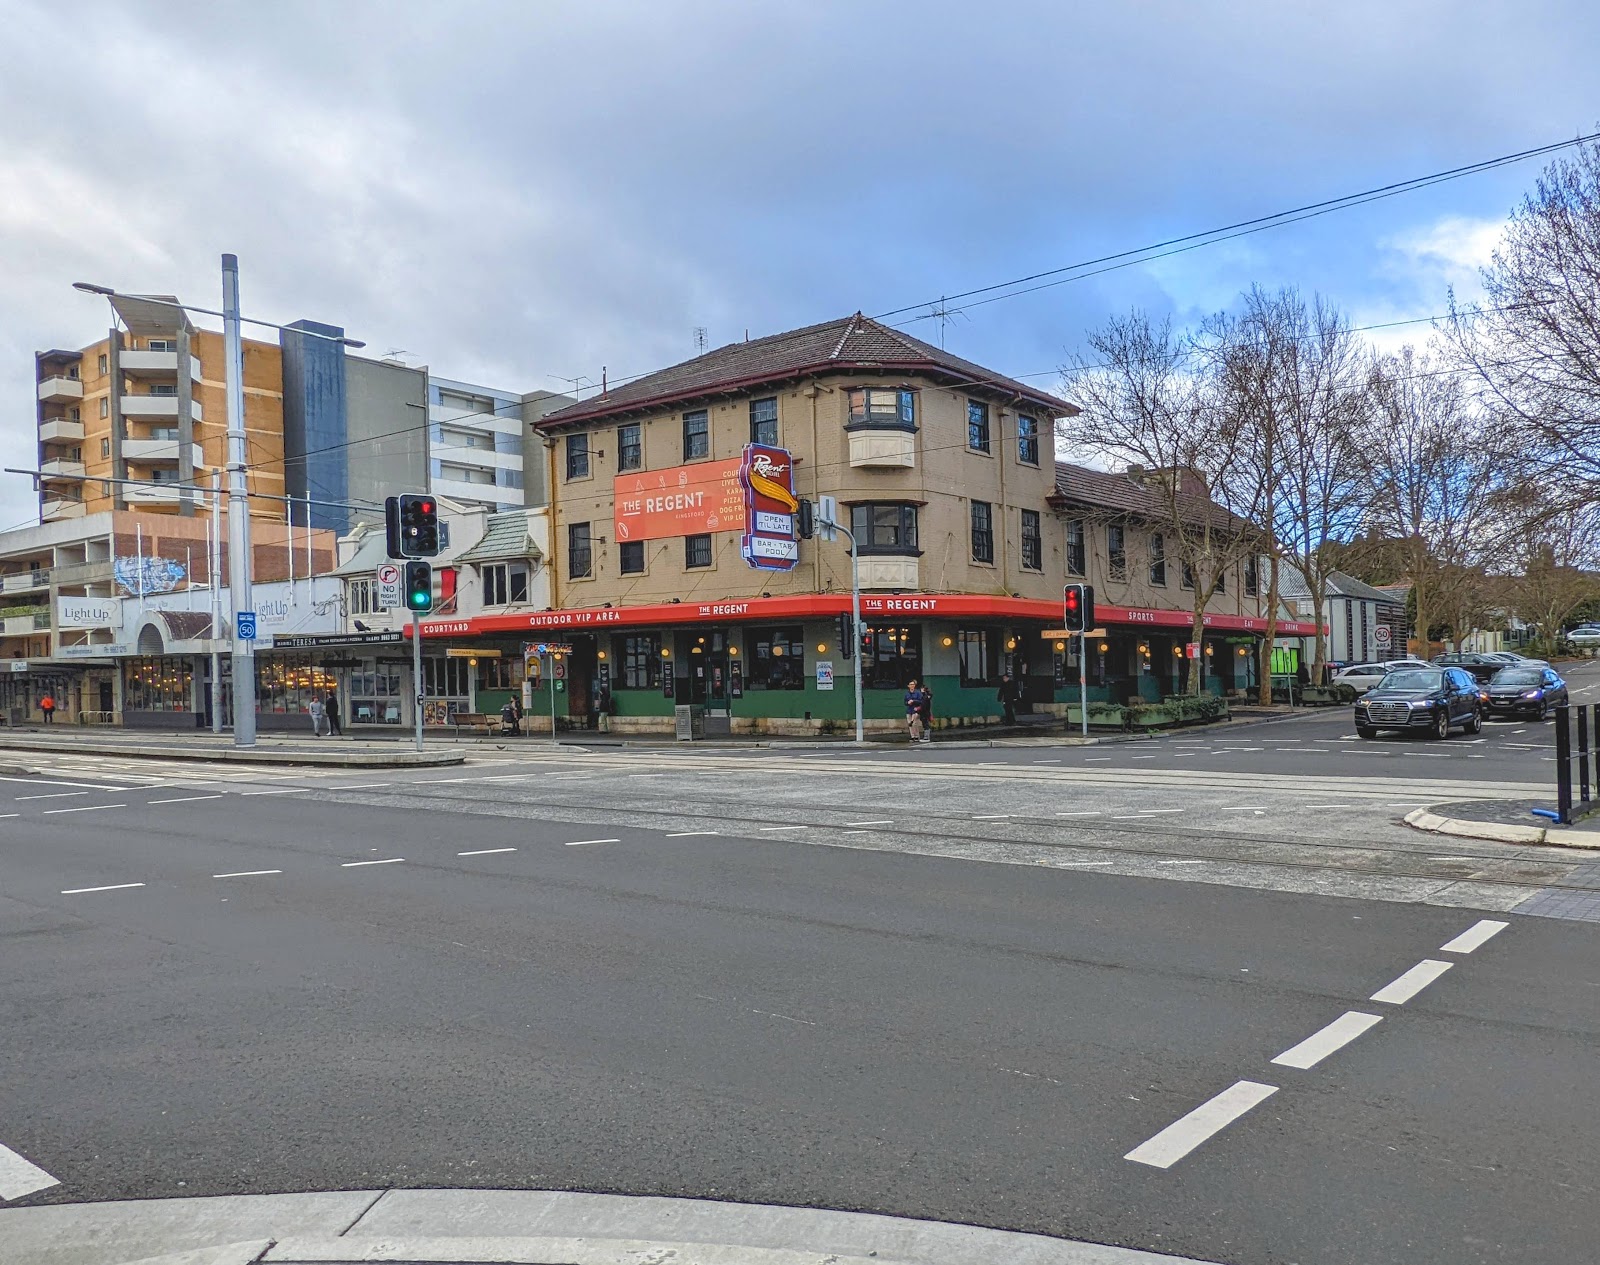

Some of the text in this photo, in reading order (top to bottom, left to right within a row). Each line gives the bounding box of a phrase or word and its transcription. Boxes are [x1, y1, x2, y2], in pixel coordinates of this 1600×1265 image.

[753, 454, 790, 478] Regent
[721, 479, 735, 487] LIVE
[726, 487, 744, 496] KARA
[622, 491, 704, 514] THE REGENT
[723, 496, 742, 505] PIZZA
[719, 506, 733, 514] DOG
[675, 511, 705, 519] KINGSFORD
[735, 513, 744, 521] LO
[764, 515, 784, 523] OPEN
[757, 540, 772, 548] BAR
[778, 542, 792, 550] TAB
[765, 548, 785, 556] POOL
[382, 585, 395, 593] NO
[713, 603, 749, 615] REGENT
[886, 600, 937, 610] REGENT
[64, 607, 91, 621] Light
[93, 608, 109, 622] Up
[254, 600, 274, 623] Light
[275, 599, 289, 621] Up
[529, 611, 620, 626] OUTDOOR VIP AREA
[1128, 611, 1154, 622] SPORTS
[423, 622, 469, 634] COURTYARD
[1244, 620, 1254, 628] EAT
[241, 626, 253, 634] 50
[1377, 630, 1388, 638] 50
[292, 637, 317, 647] TERESA
